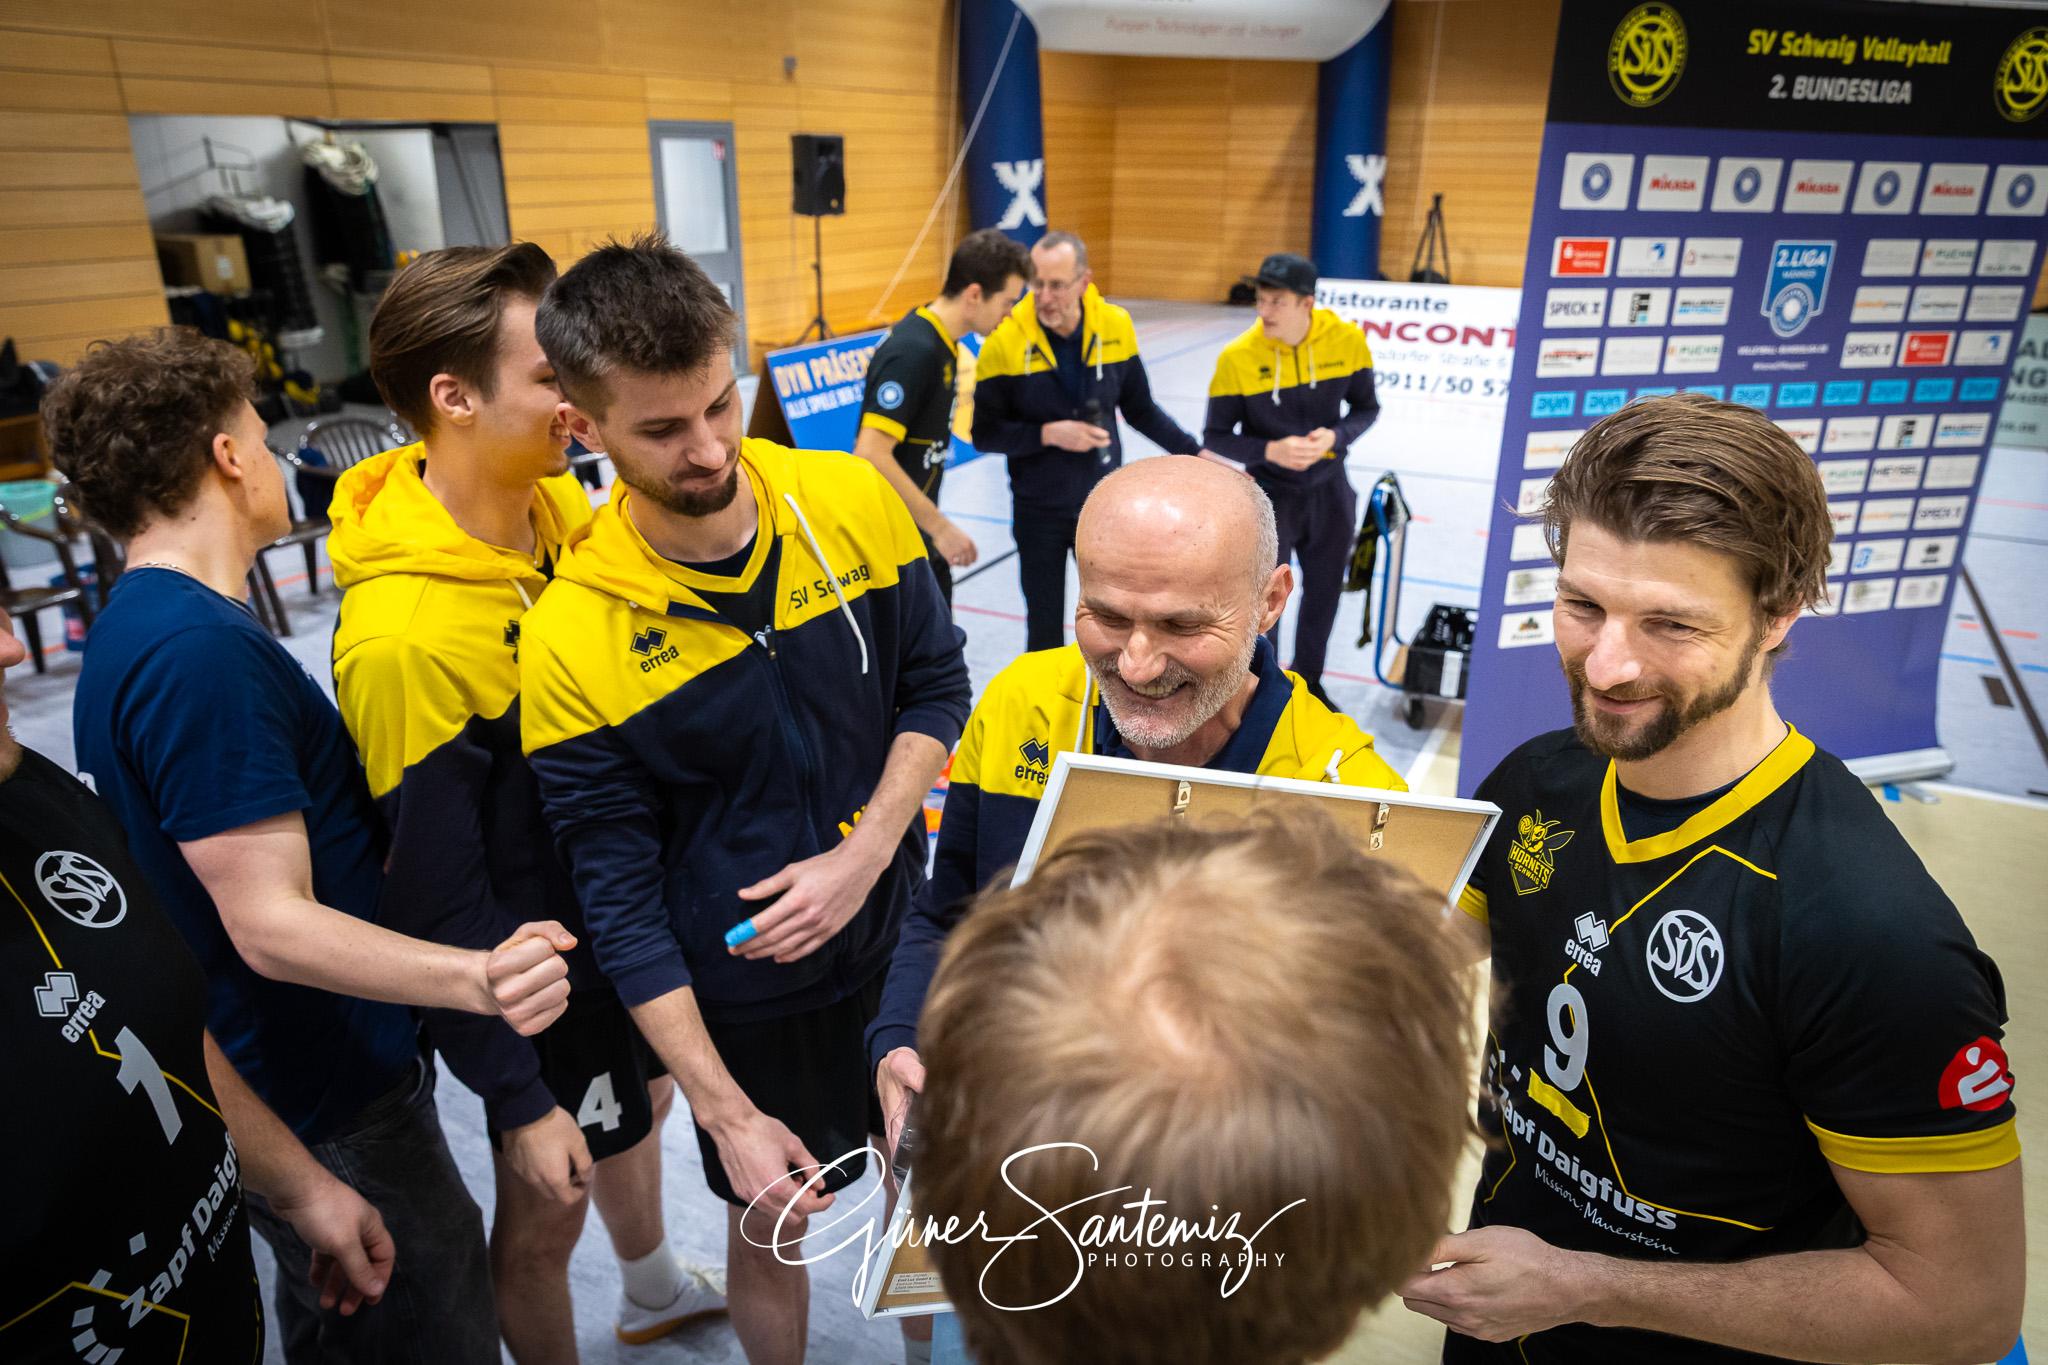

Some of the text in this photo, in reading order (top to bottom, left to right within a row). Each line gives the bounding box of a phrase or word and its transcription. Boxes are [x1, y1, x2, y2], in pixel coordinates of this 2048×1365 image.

[1747, 29, 1951, 68] SV Schwaig Volleyball
[1768, 74, 1912, 104] 2. BUNDESLIGA
[1315, 288, 1449, 314] Ristorante
[790, 586, 809, 609] SV
[1509, 845, 1550, 884] HORNETS
[1513, 862, 1540, 885] SCHWAIG
[1543, 983, 1589, 1092] 9
[114, 1026, 183, 1146] 1
[577, 1071, 623, 1132] 4
[1537, 1131, 1677, 1230] Daigfuss
[120, 1222, 195, 1329] Zapf
